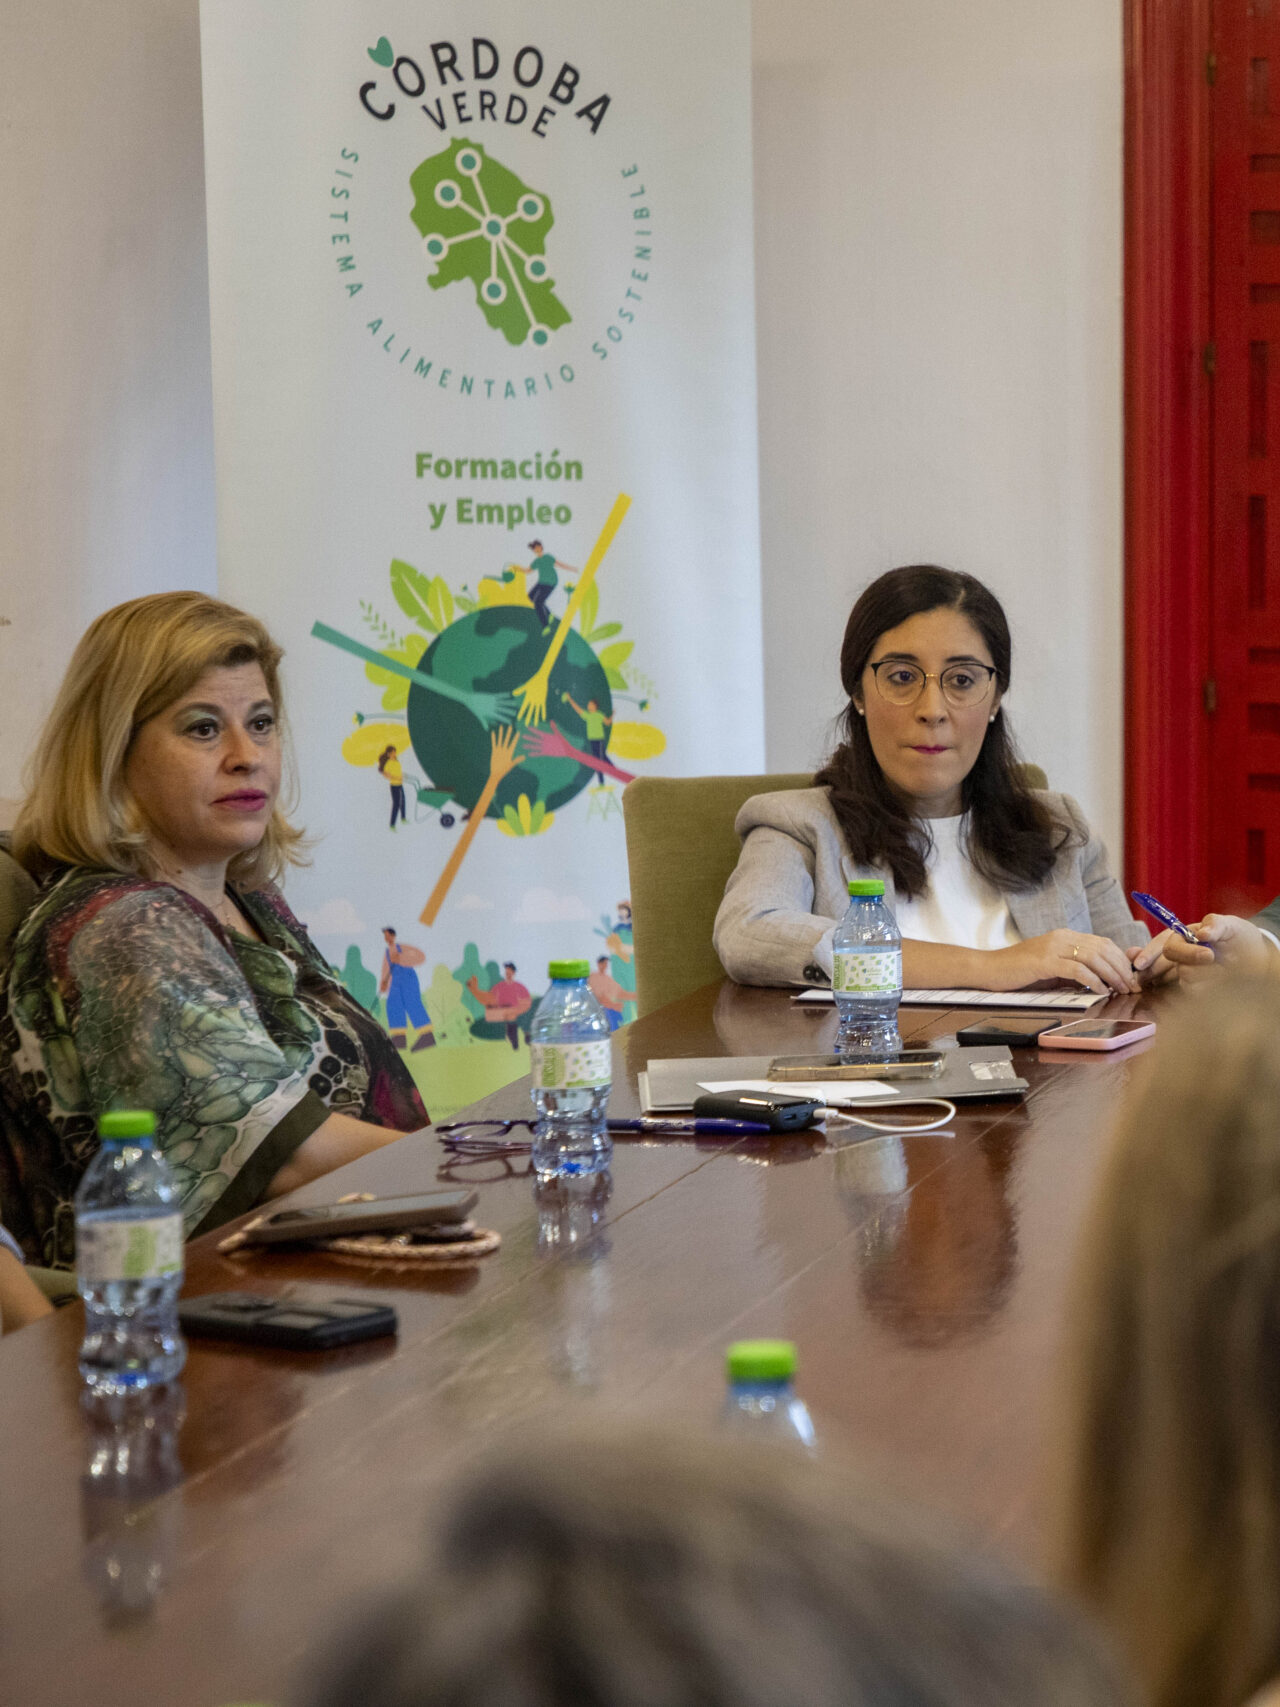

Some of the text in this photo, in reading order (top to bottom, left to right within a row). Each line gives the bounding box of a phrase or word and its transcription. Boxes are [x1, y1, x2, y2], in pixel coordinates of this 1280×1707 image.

[422, 90, 556, 138] VERDE
[330, 147, 364, 299] SISTEMA
[592, 164, 652, 361] SOSTENIBLE
[366, 317, 576, 401] ALIMENTARIO
[415, 449, 583, 481] Formación
[429, 498, 572, 530] y Empleo
